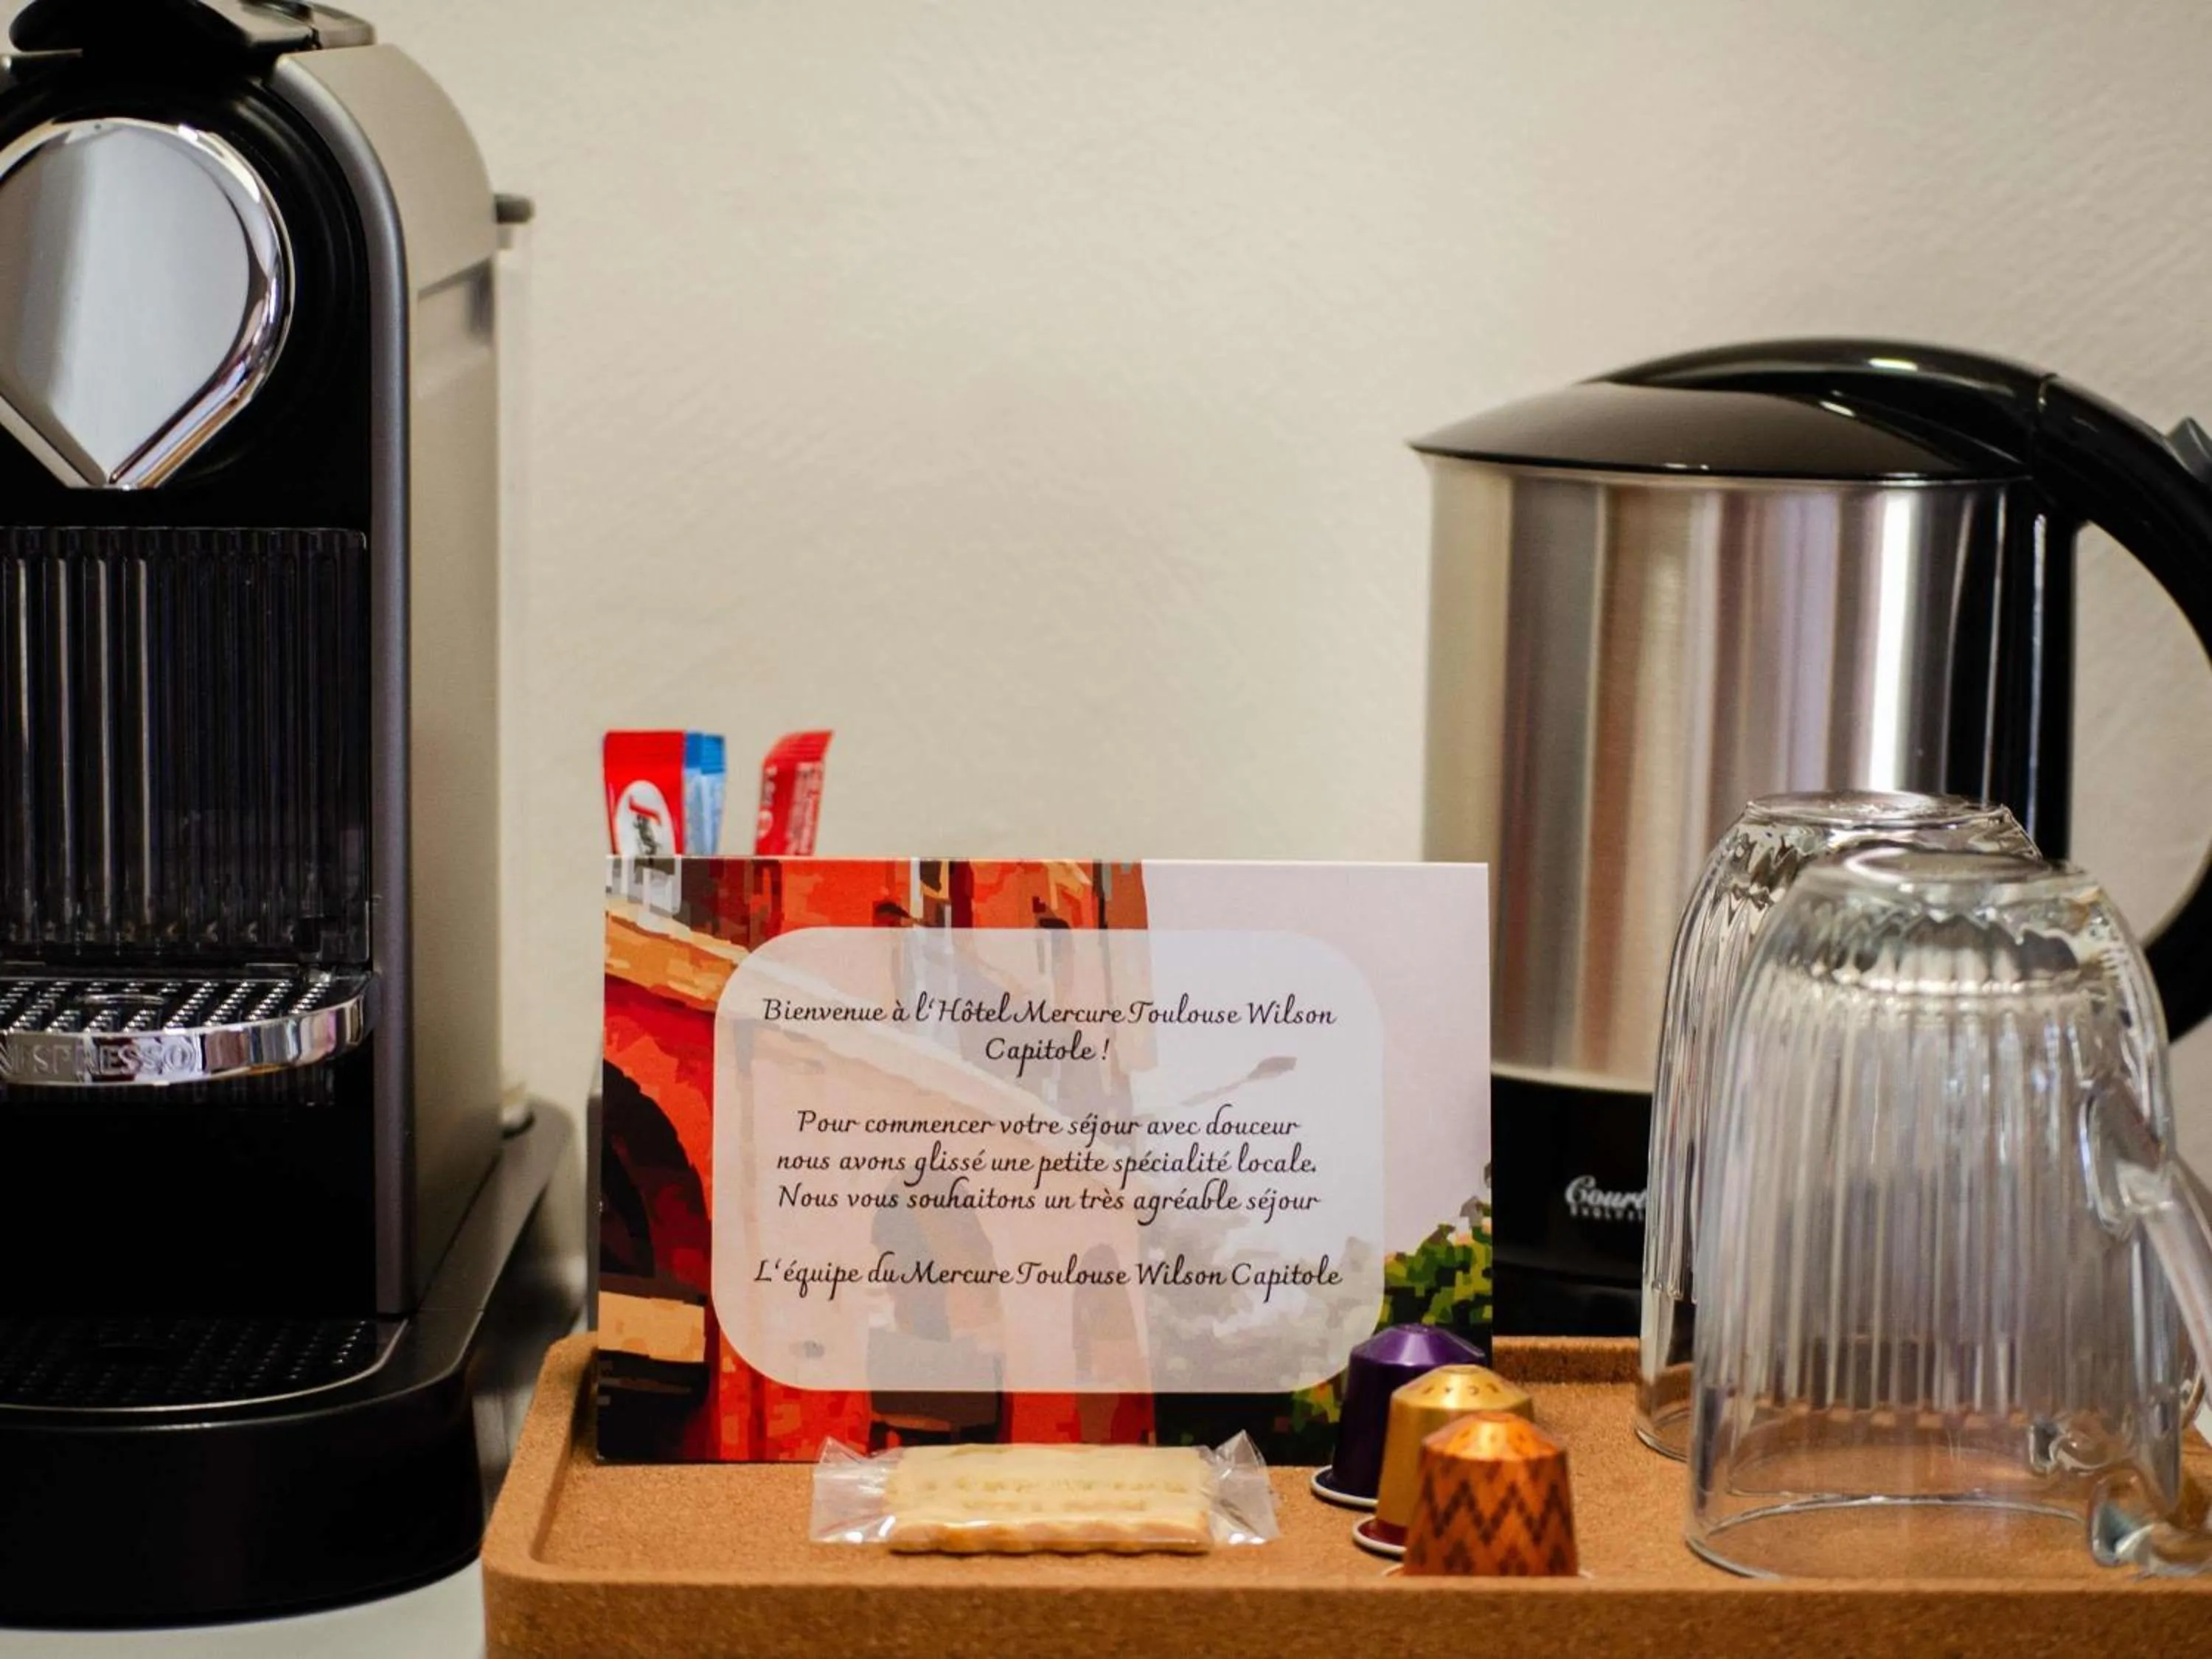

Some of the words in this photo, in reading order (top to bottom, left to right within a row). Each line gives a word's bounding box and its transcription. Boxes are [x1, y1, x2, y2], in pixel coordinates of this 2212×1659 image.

[762, 998, 886, 1022] Bienvenue
[891, 1001, 910, 1022] à
[1013, 999, 1127, 1023] Mercure
[1127, 992, 1242, 1024] Toulouse
[1247, 993, 1337, 1024] Wilson
[797, 1110, 861, 1133] Pour
[864, 1116, 997, 1135] commencer
[999, 1113, 1063, 1135] votre
[1068, 1112, 1143, 1148] séjour
[1147, 1119, 1201, 1135] avec
[1206, 1103, 1301, 1135] douceur
[776, 1154, 831, 1171] nous
[839, 1155, 905, 1171] avons
[903, 1140, 987, 1187] glissé
[991, 1155, 1035, 1172] une
[1034, 1151, 1109, 1189] petite
[1113, 1141, 1232, 1190] spécialité
[1237, 1141, 1317, 1172] locale.
[778, 1182, 839, 1208] Nous
[846, 1192, 899, 1208] vous
[906, 1176, 1036, 1209] souhaitons
[1044, 1194, 1076, 1210] un
[1079, 1188, 1125, 1210] très
[1133, 1177, 1242, 1226] agréable
[1246, 1188, 1321, 1224] séjour
[867, 1251, 900, 1284] du
[900, 1259, 1015, 1284] Mercure
[1015, 1253, 1131, 1285] Toulouse
[1135, 1253, 1228, 1285] Wilson
[1232, 1253, 1343, 1303] Capitole
